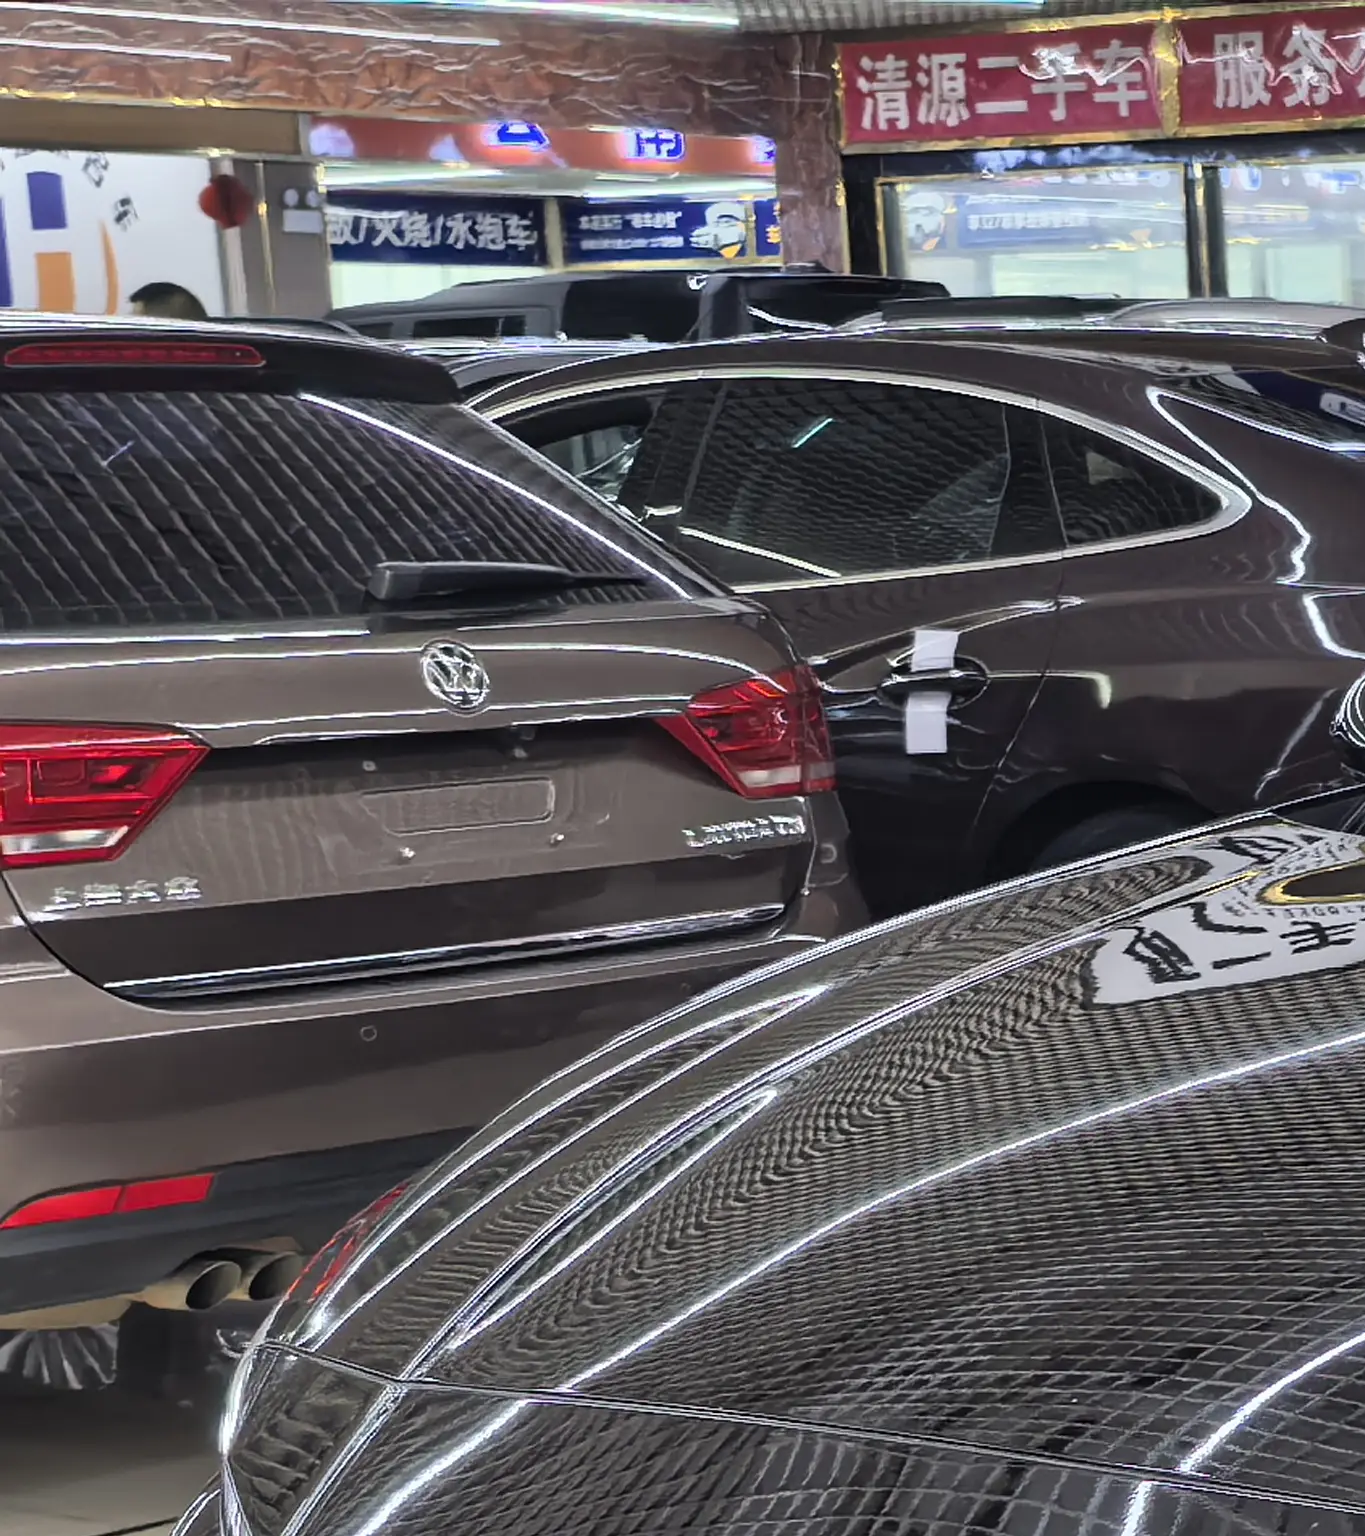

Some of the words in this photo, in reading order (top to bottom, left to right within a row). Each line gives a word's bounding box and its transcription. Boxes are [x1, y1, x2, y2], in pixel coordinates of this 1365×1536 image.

[857, 39, 1148, 130] 清源二手车
